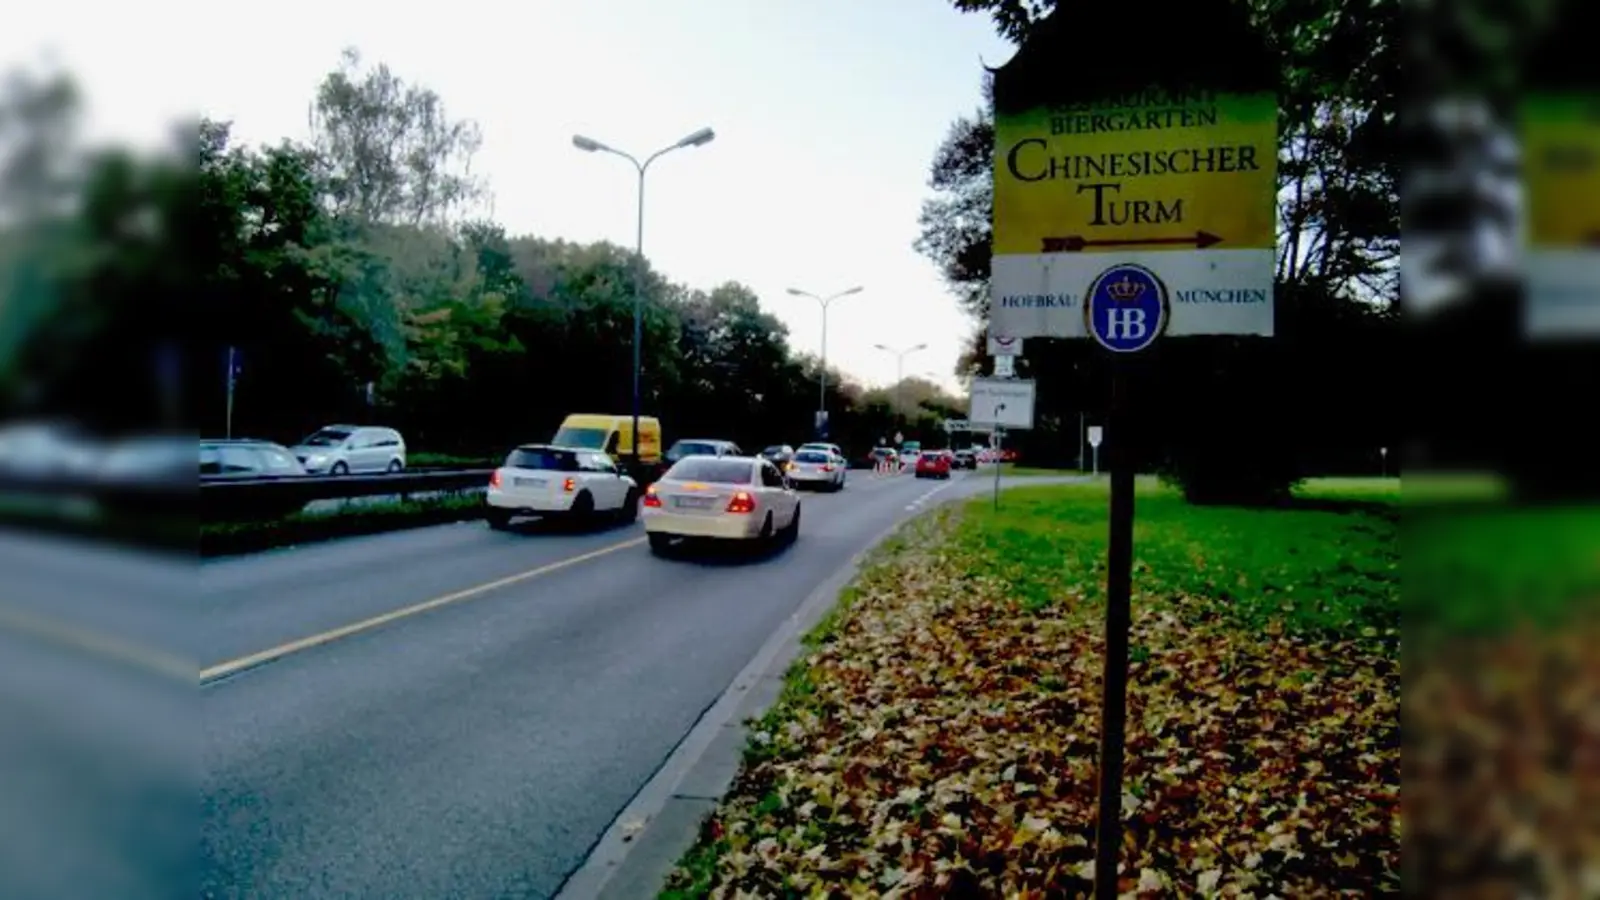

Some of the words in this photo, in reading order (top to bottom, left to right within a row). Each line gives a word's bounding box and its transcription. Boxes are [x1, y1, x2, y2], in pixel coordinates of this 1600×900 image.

[1007, 138, 1260, 182] CHINESISCHER
[1077, 184, 1183, 226] TURM
[1106, 307, 1147, 339] HB
